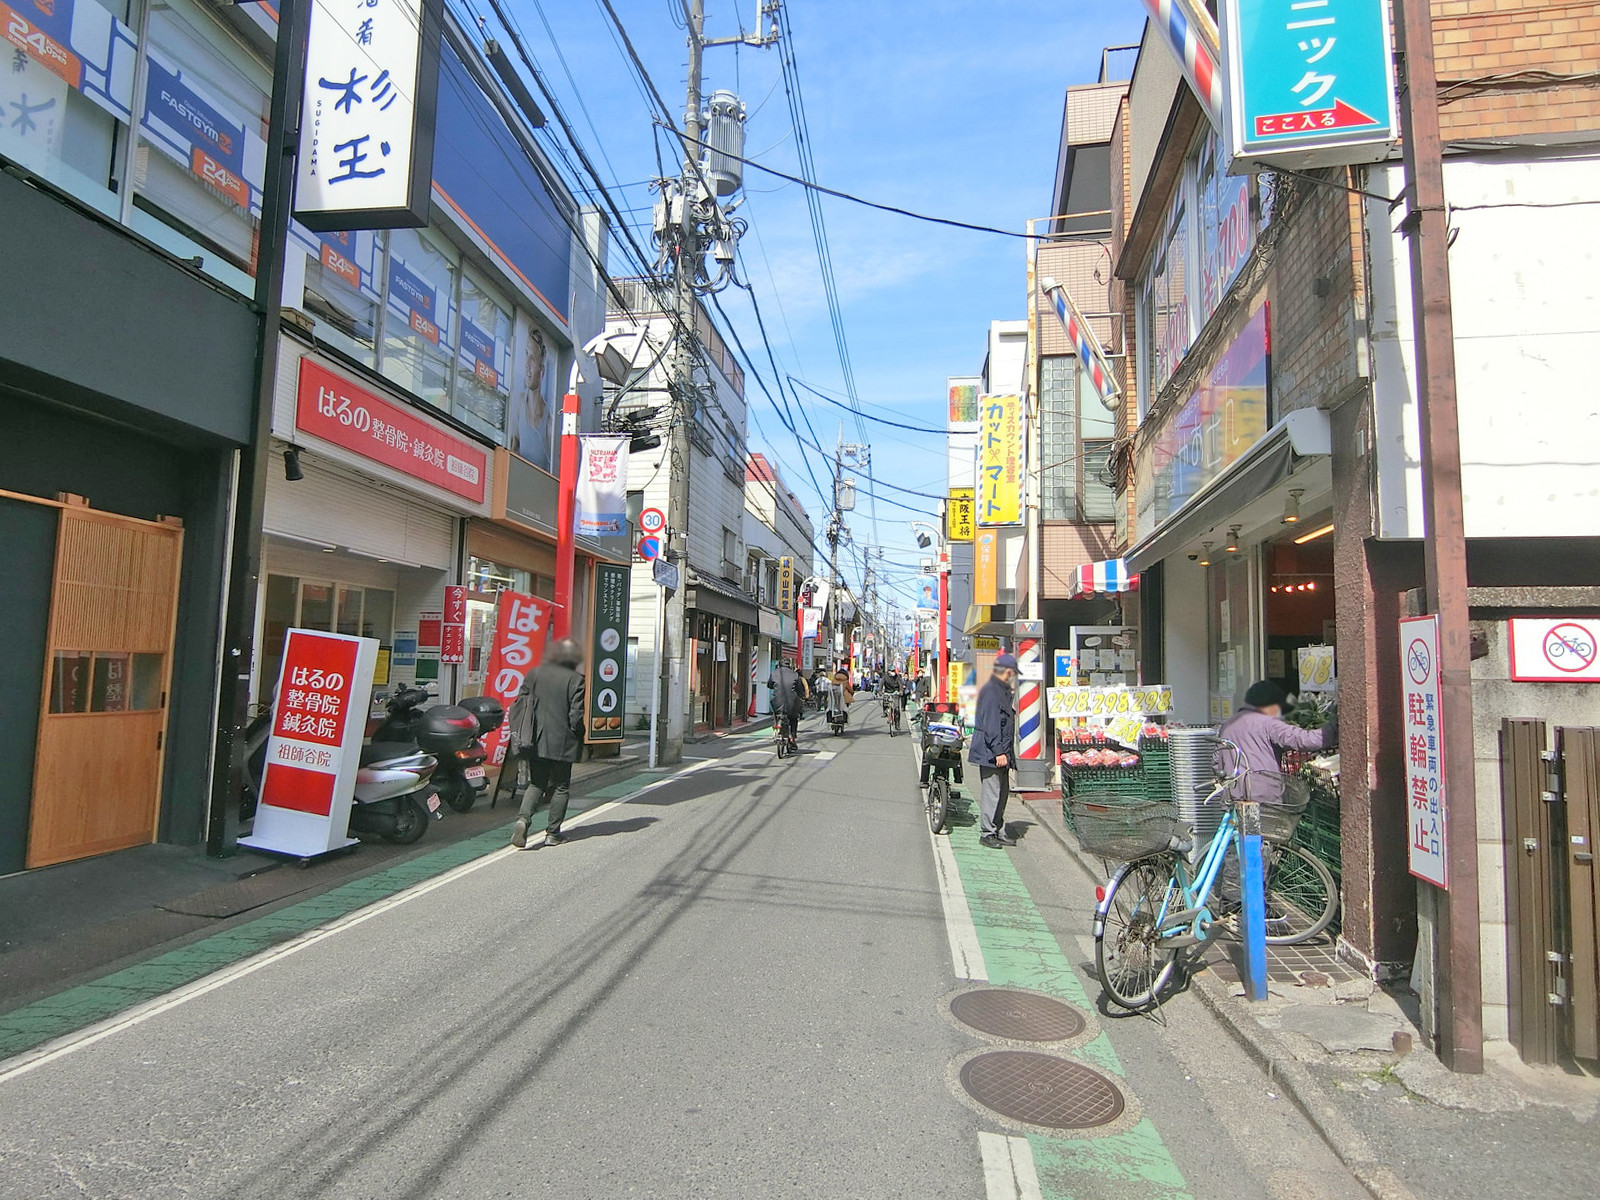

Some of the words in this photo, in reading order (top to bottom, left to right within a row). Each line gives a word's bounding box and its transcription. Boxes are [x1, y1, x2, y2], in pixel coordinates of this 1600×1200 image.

[310, 100, 322, 176] SUGIDAMA
[318, 67, 397, 185] 杉玉
[1262, 112, 1336, 132] ここ入る
[987, 403, 1003, 449] カット
[986, 465, 1003, 517] マート
[644, 514, 660, 526] 30
[452, 588, 463, 622] 今すぐ
[494, 599, 542, 698] はるの
[291, 666, 344, 691] はるの
[287, 688, 341, 715] 整骨院
[282, 711, 336, 738] 鍼灸院
[277, 743, 332, 767] 祖師谷院
[1408, 692, 1430, 854] 駐輪禁止
[1425, 693, 1440, 857] 緊急車両の出入口
